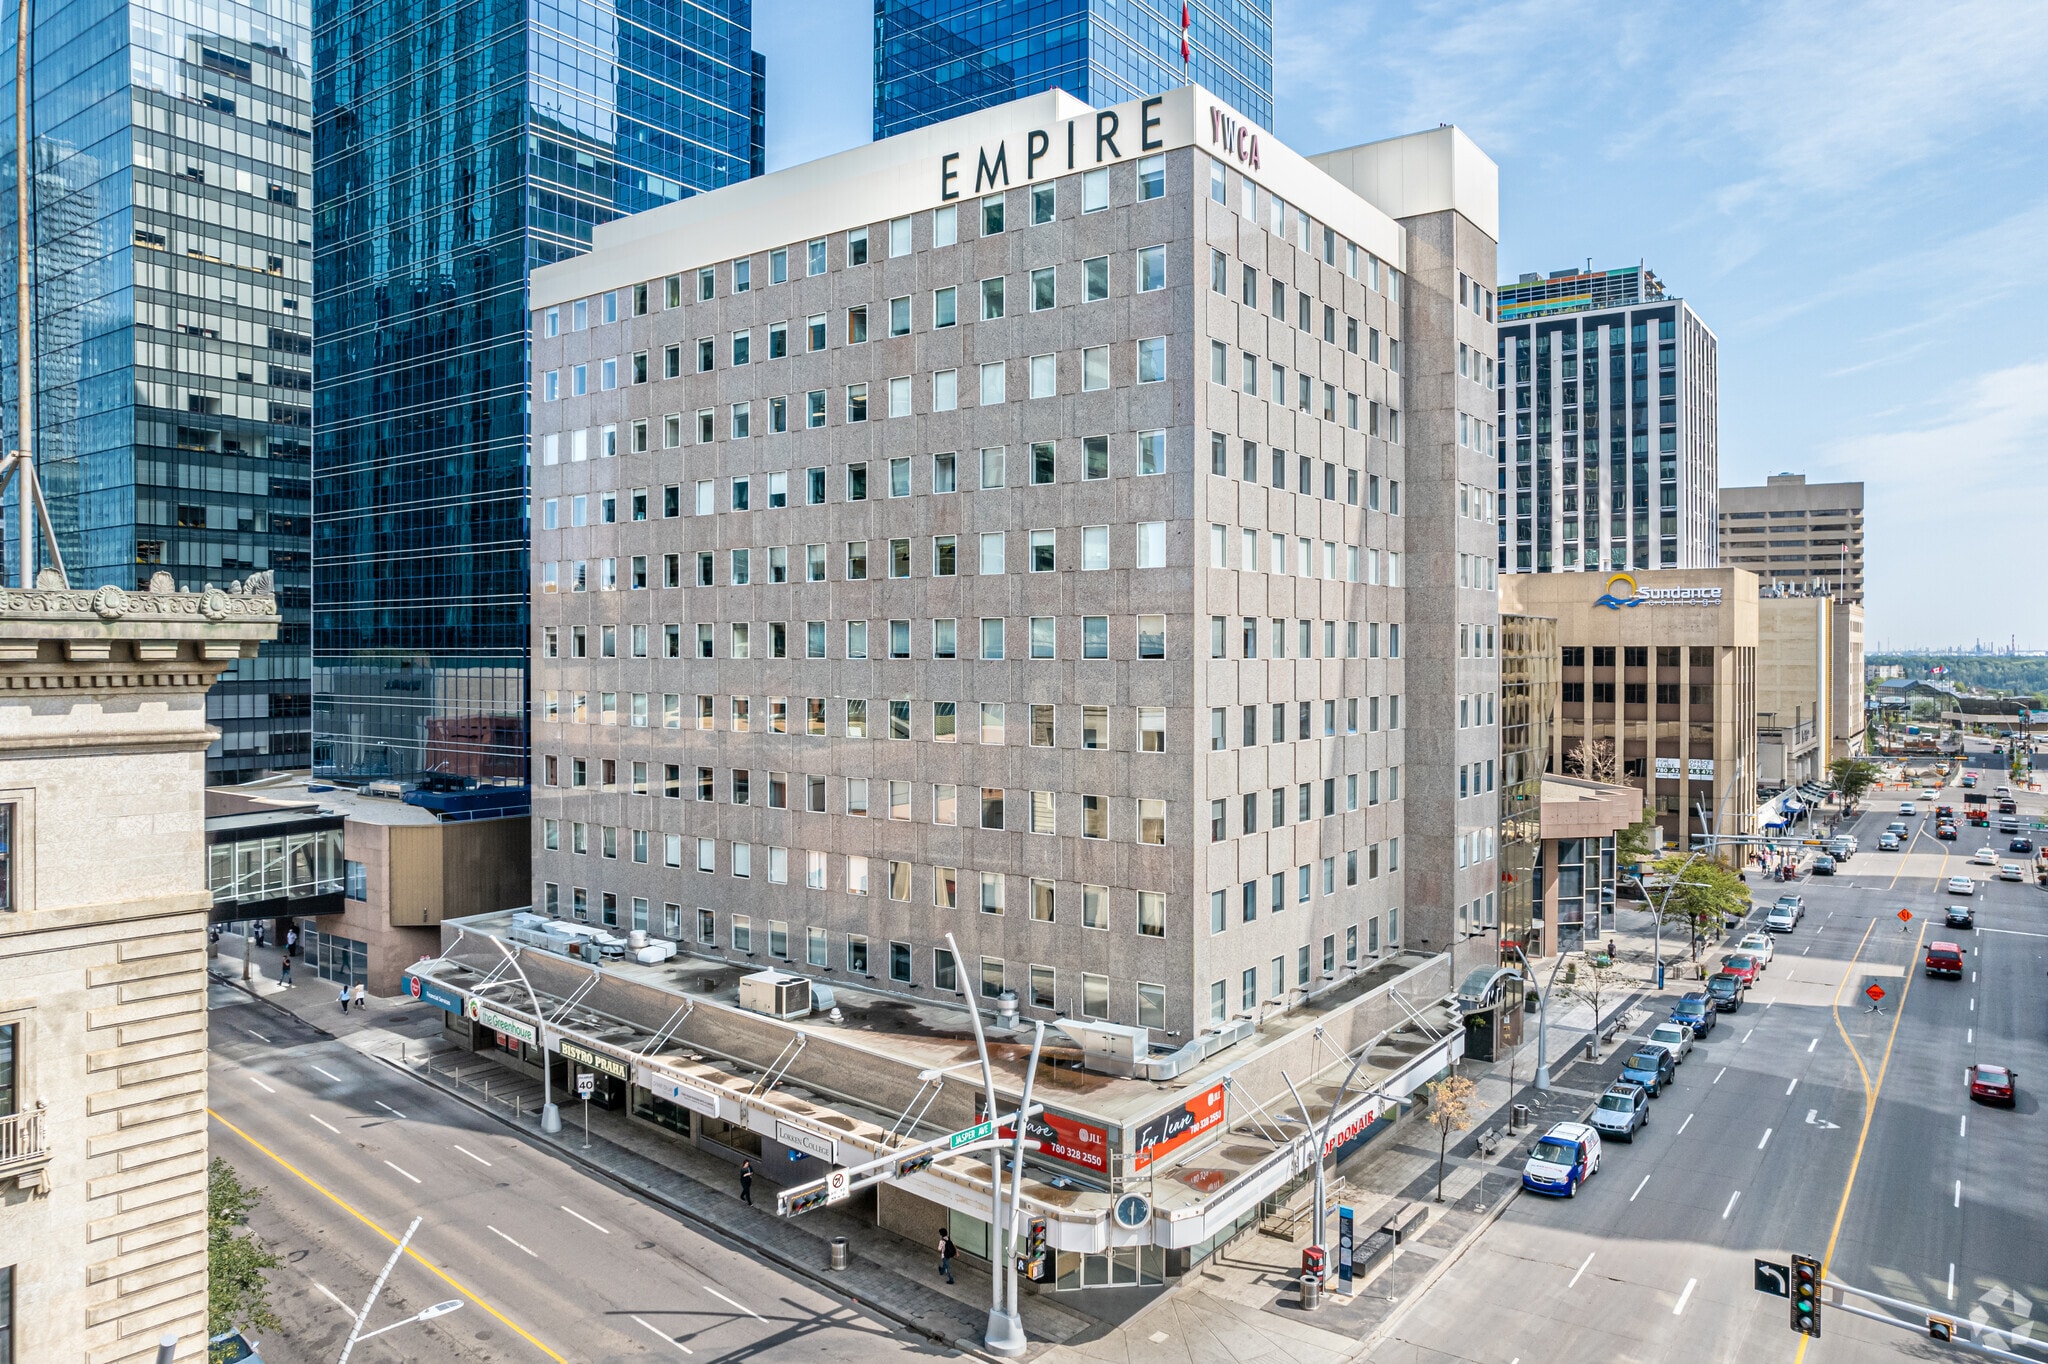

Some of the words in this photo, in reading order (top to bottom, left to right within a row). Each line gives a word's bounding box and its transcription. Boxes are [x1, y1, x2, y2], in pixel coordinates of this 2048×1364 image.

[942, 96, 1163, 201] EMPIRE
[1210, 105, 1261, 174] YWCA
[1639, 586, 1722, 599] Sundance
[1648, 598, 1722, 607] college
[482, 1012, 492, 1024] the
[492, 1015, 532, 1040] Greenhouse
[561, 1043, 593, 1065] BISTRO
[595, 1056, 625, 1078] PRAHA
[579, 1081, 593, 1090] 40
[954, 1129, 976, 1145] JASPER
[978, 1124, 988, 1135] AVE
[1010, 1108, 1053, 1137] Lase
[1140, 1126, 1159, 1154] For
[1162, 1113, 1193, 1144] Lease
[1337, 1109, 1375, 1147] DONAIR
[802, 1137, 830, 1157] COLLEGE
[1088, 1133, 1102, 1144] JLL
[1051, 1142, 1066, 1155] 780
[1066, 1146, 1081, 1160] 328
[1082, 1151, 1102, 1166] 2550
